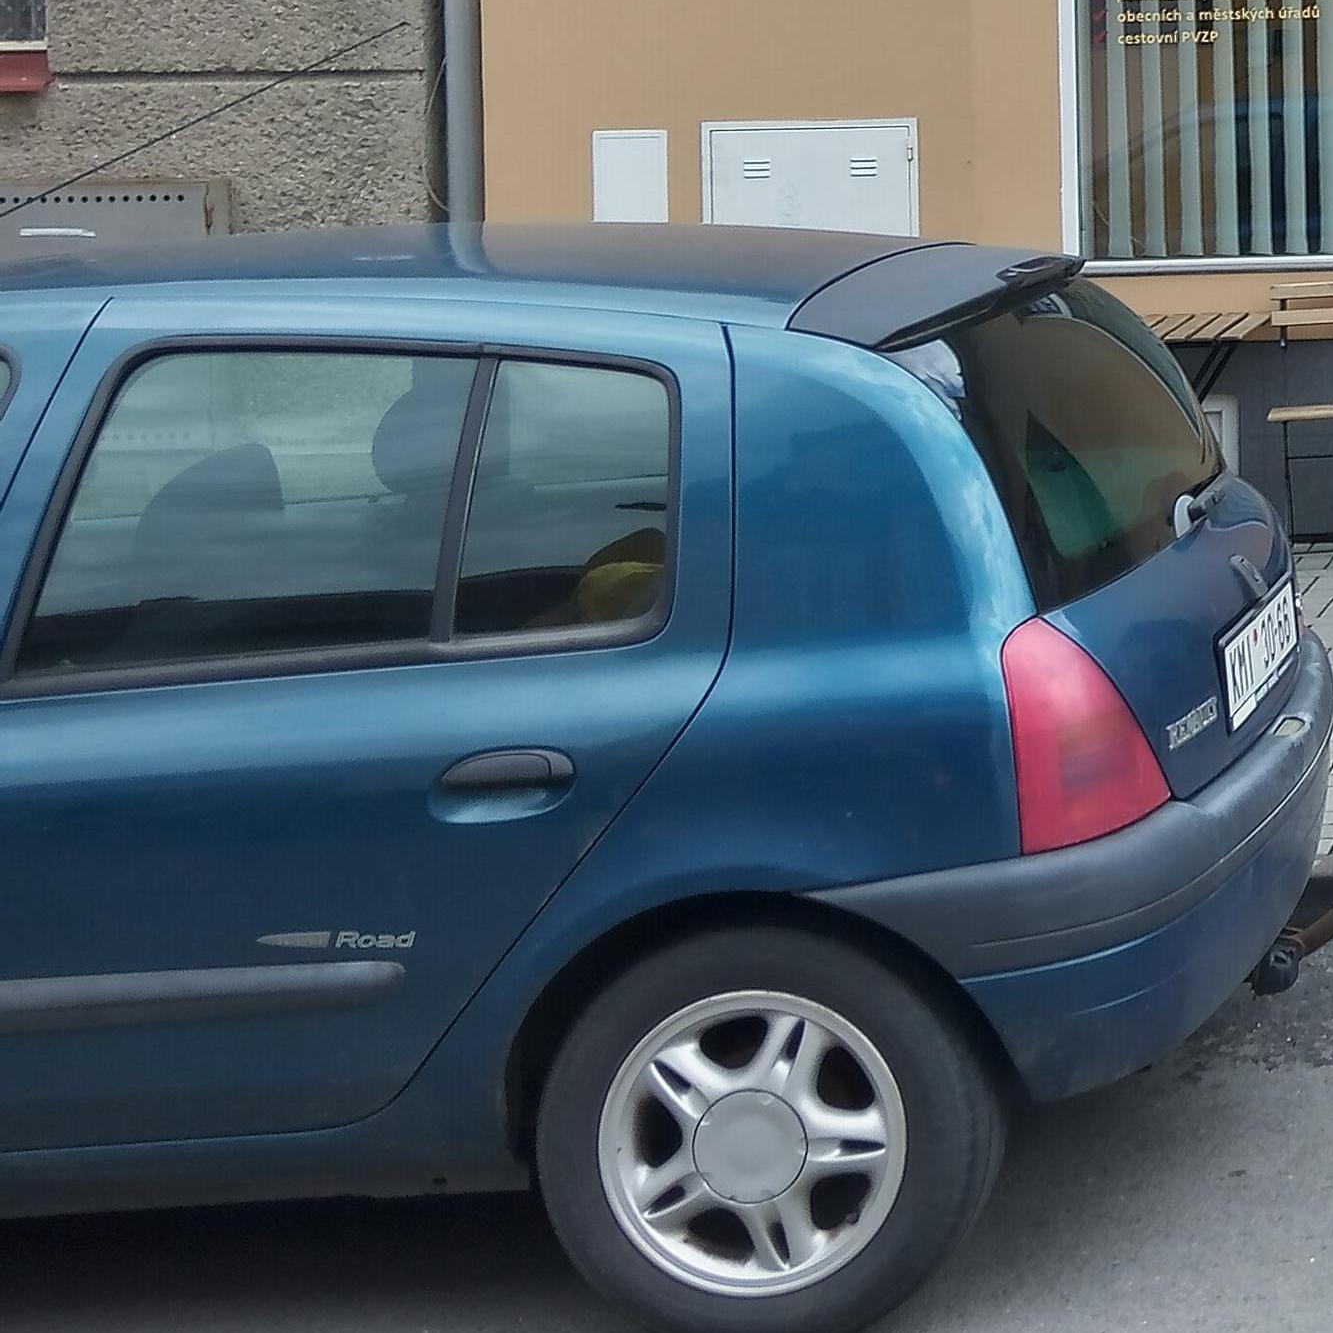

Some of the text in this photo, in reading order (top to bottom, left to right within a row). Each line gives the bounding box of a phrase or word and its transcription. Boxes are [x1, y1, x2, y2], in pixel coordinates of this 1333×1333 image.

[1117, 6, 1320, 23] obecních a městských úřadů
[1117, 31, 1218, 46] cestovní PVZP
[335, 930, 416, 949] Road
